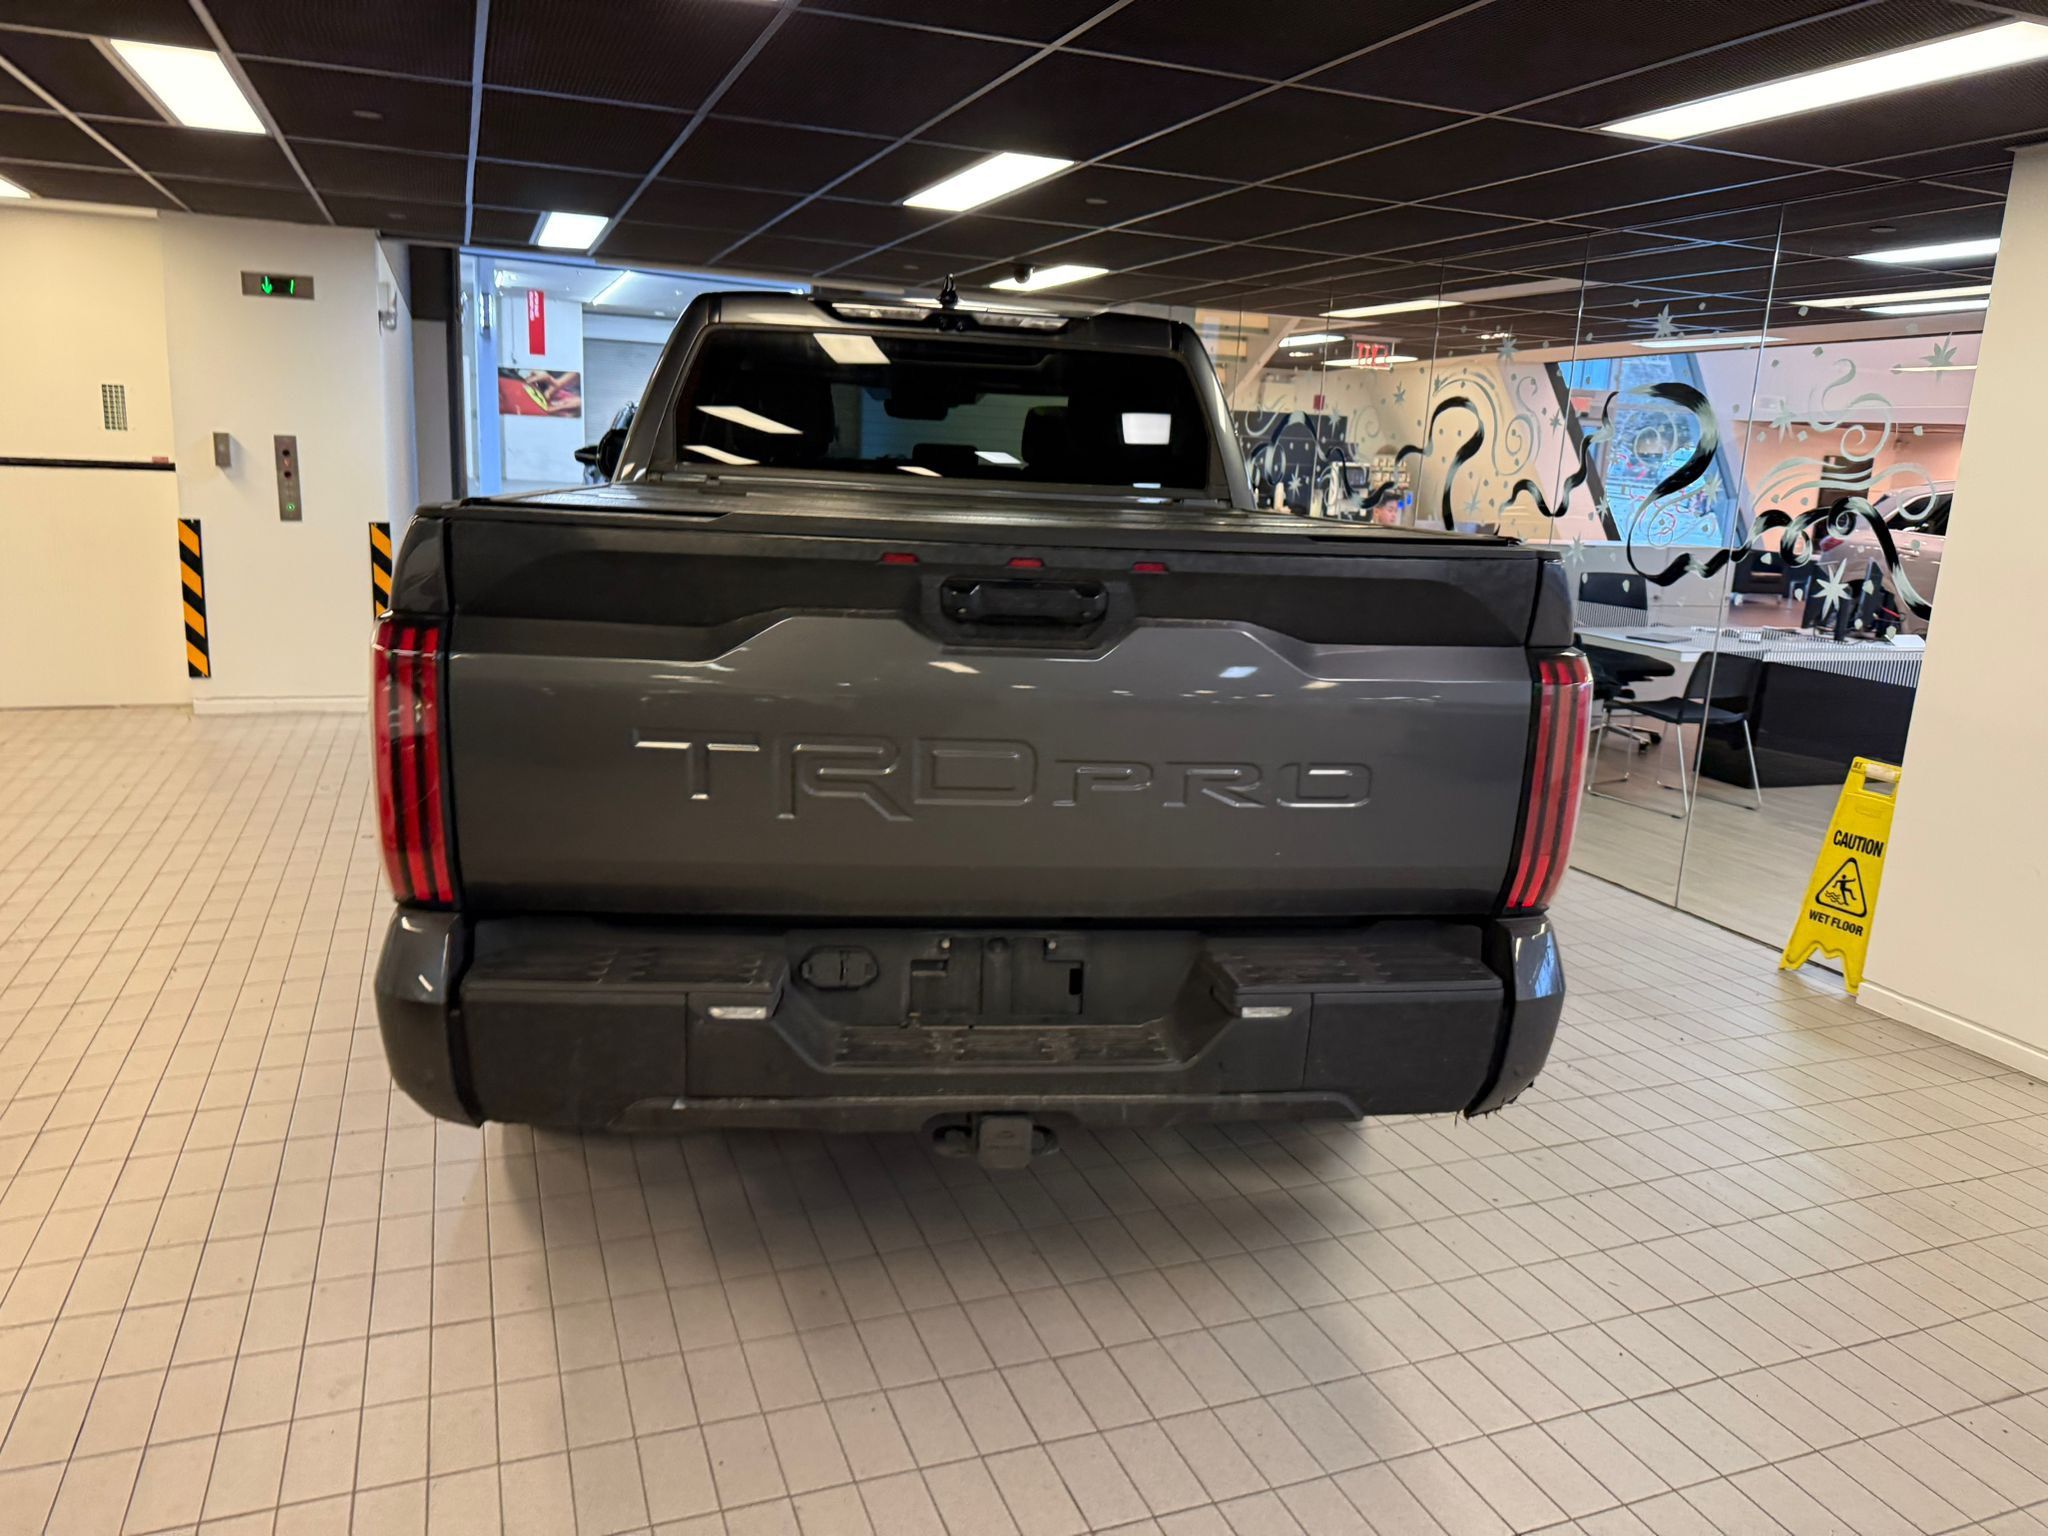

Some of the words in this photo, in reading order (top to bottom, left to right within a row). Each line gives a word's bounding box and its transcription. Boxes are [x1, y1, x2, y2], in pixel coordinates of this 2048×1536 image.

[632, 727, 1040, 821] TRD
[1052, 759, 1373, 808] PRO
[1833, 829, 1884, 858] CAUTION
[1809, 909, 1830, 925] WET
[1831, 917, 1864, 937] FLOOR
